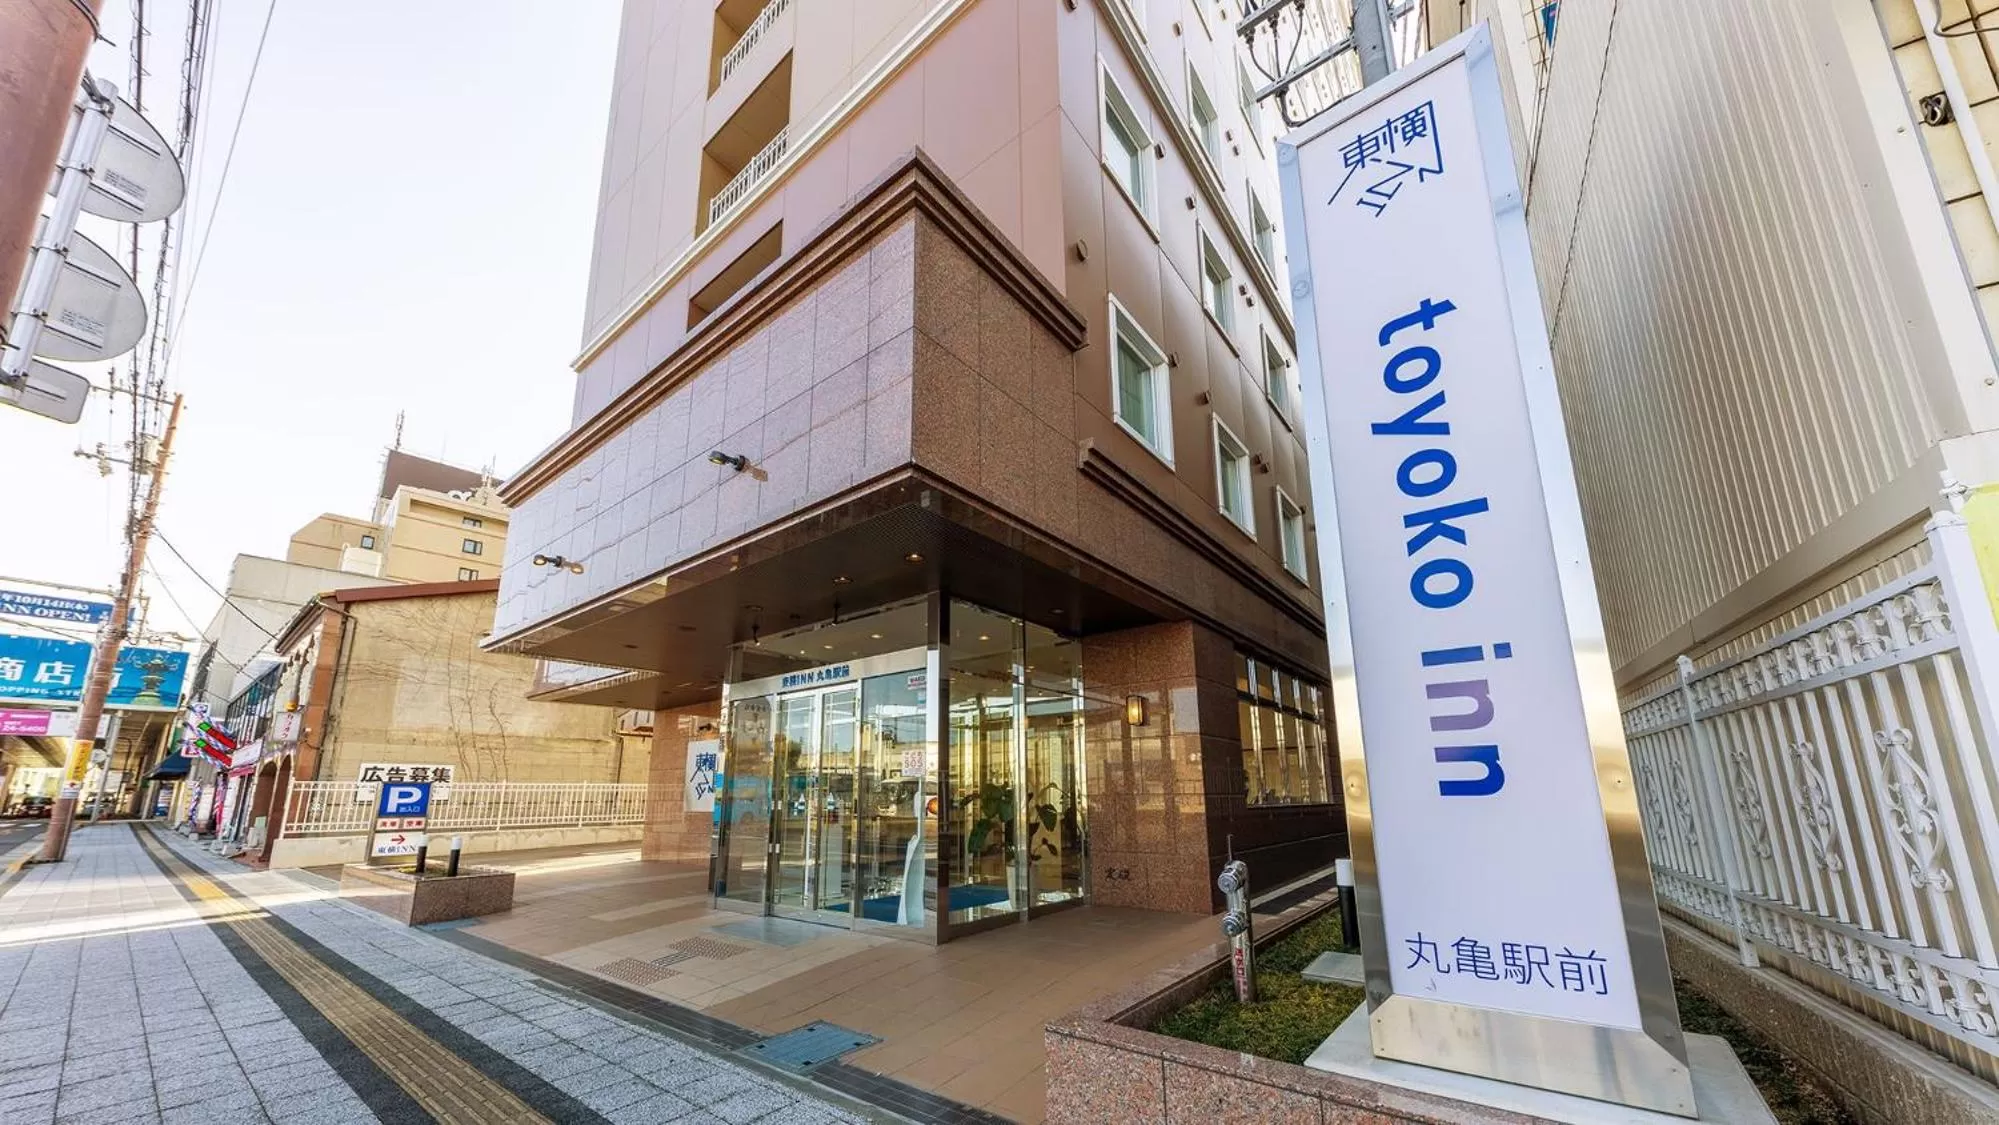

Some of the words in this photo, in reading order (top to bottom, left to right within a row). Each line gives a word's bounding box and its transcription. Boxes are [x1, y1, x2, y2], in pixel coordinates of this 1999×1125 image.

[1371, 298, 1489, 609] toyoko
[0, 602, 32, 615] NN
[1421, 642, 1513, 797] inn
[361, 766, 451, 783] 広告募集
[386, 786, 422, 813] P
[1405, 932, 1608, 995] 丸亀駅前
